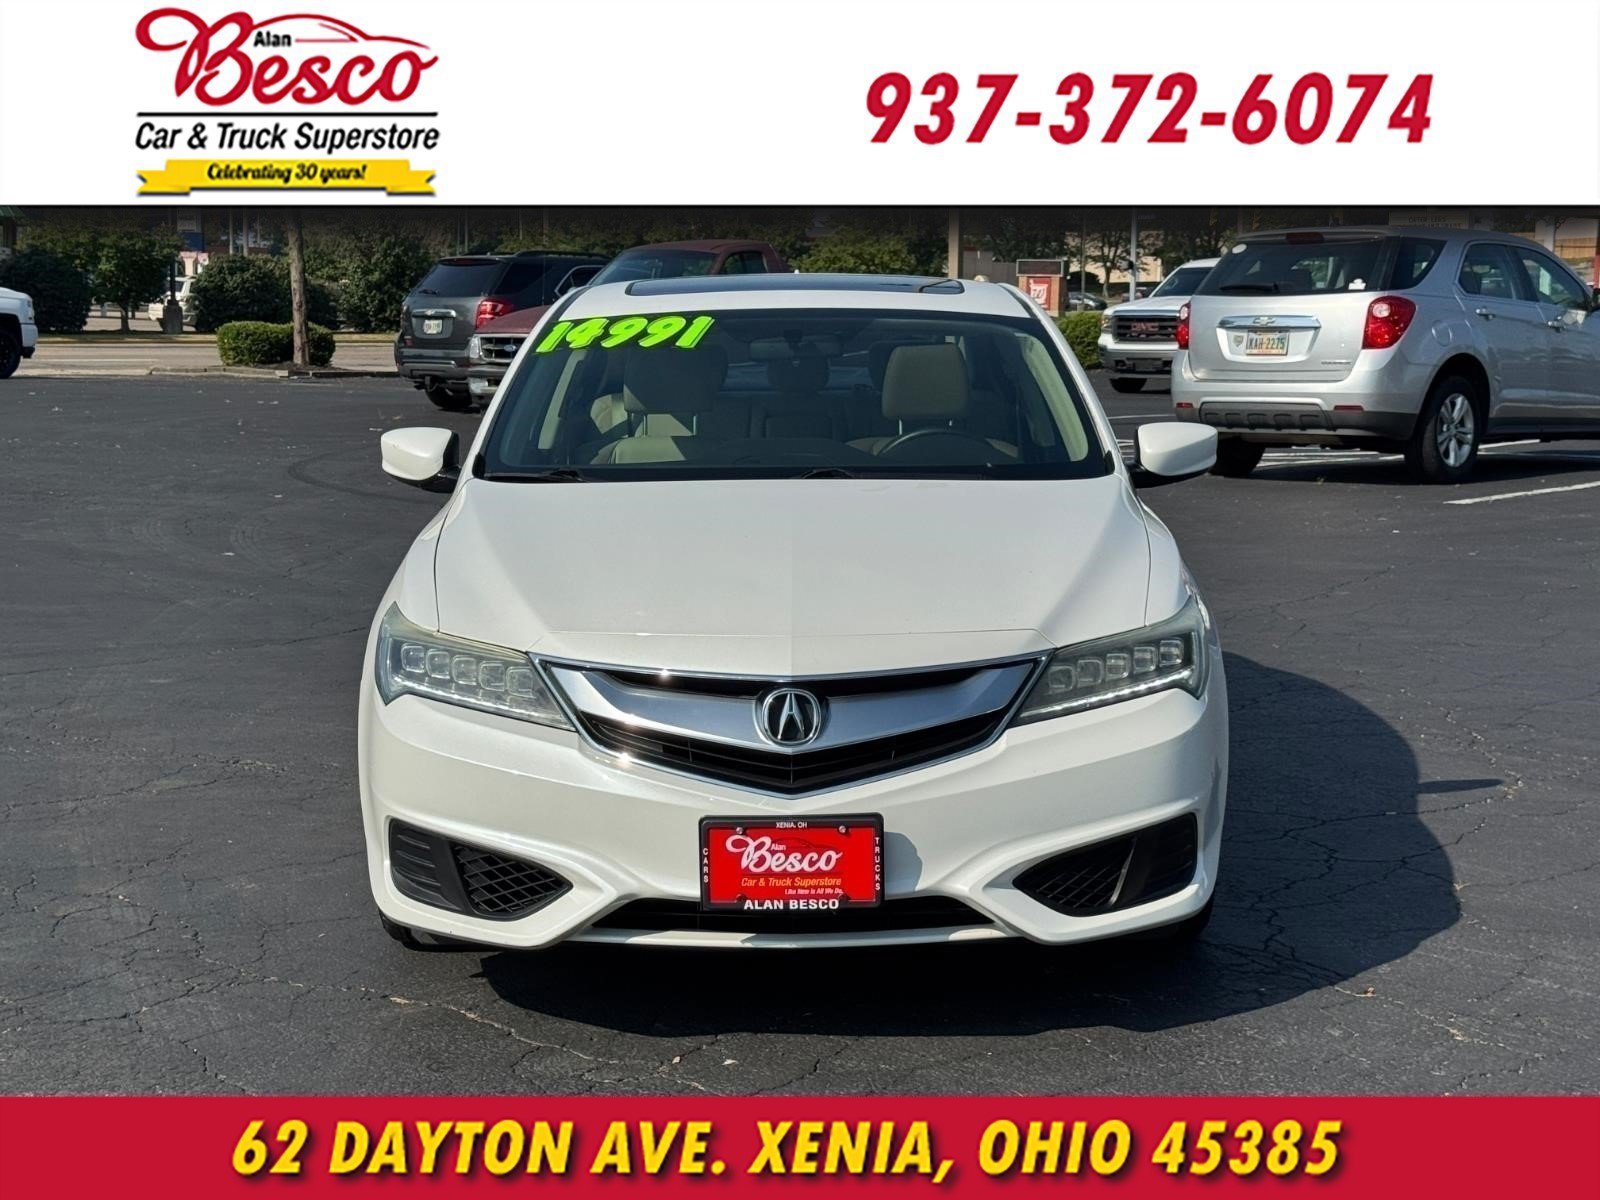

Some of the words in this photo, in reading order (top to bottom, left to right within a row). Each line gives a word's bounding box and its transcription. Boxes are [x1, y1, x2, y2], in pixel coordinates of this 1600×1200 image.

[535, 315, 715, 354] 14991
[797, 821, 808, 829] OH
[771, 843, 787, 851] Alan
[725, 834, 843, 873] Besco
[741, 877, 757, 887] Car
[758, 877, 766, 887] &
[768, 877, 792, 887] Truck
[794, 876, 842, 888] Superstore
[743, 899, 784, 910] ALAN
[789, 898, 839, 910] BESCO
